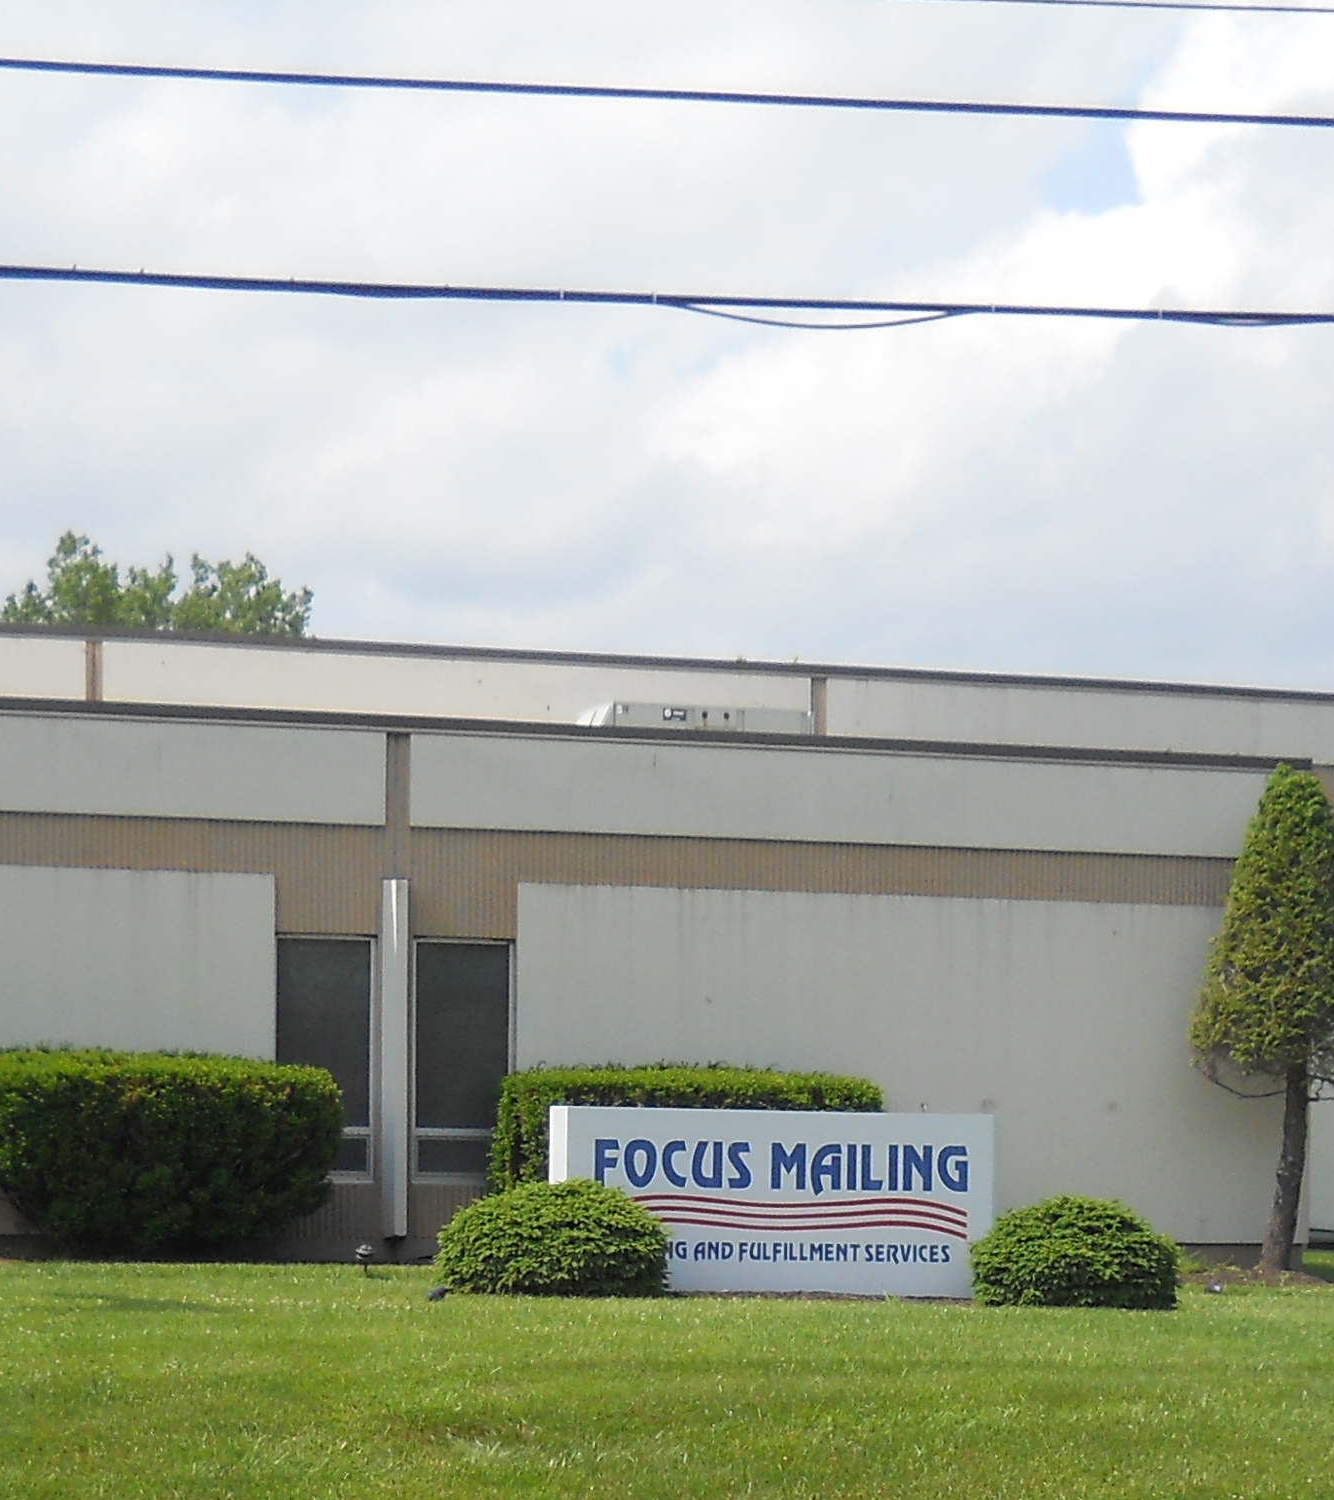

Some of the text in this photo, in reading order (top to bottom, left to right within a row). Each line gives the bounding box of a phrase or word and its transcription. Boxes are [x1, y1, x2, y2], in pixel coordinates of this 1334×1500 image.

[594, 1138, 968, 1196] FOCUS MAILING
[694, 1241, 734, 1262] AND
[739, 1242, 861, 1263] FULFILLMENT
[864, 1244, 951, 1264] SERVICES
